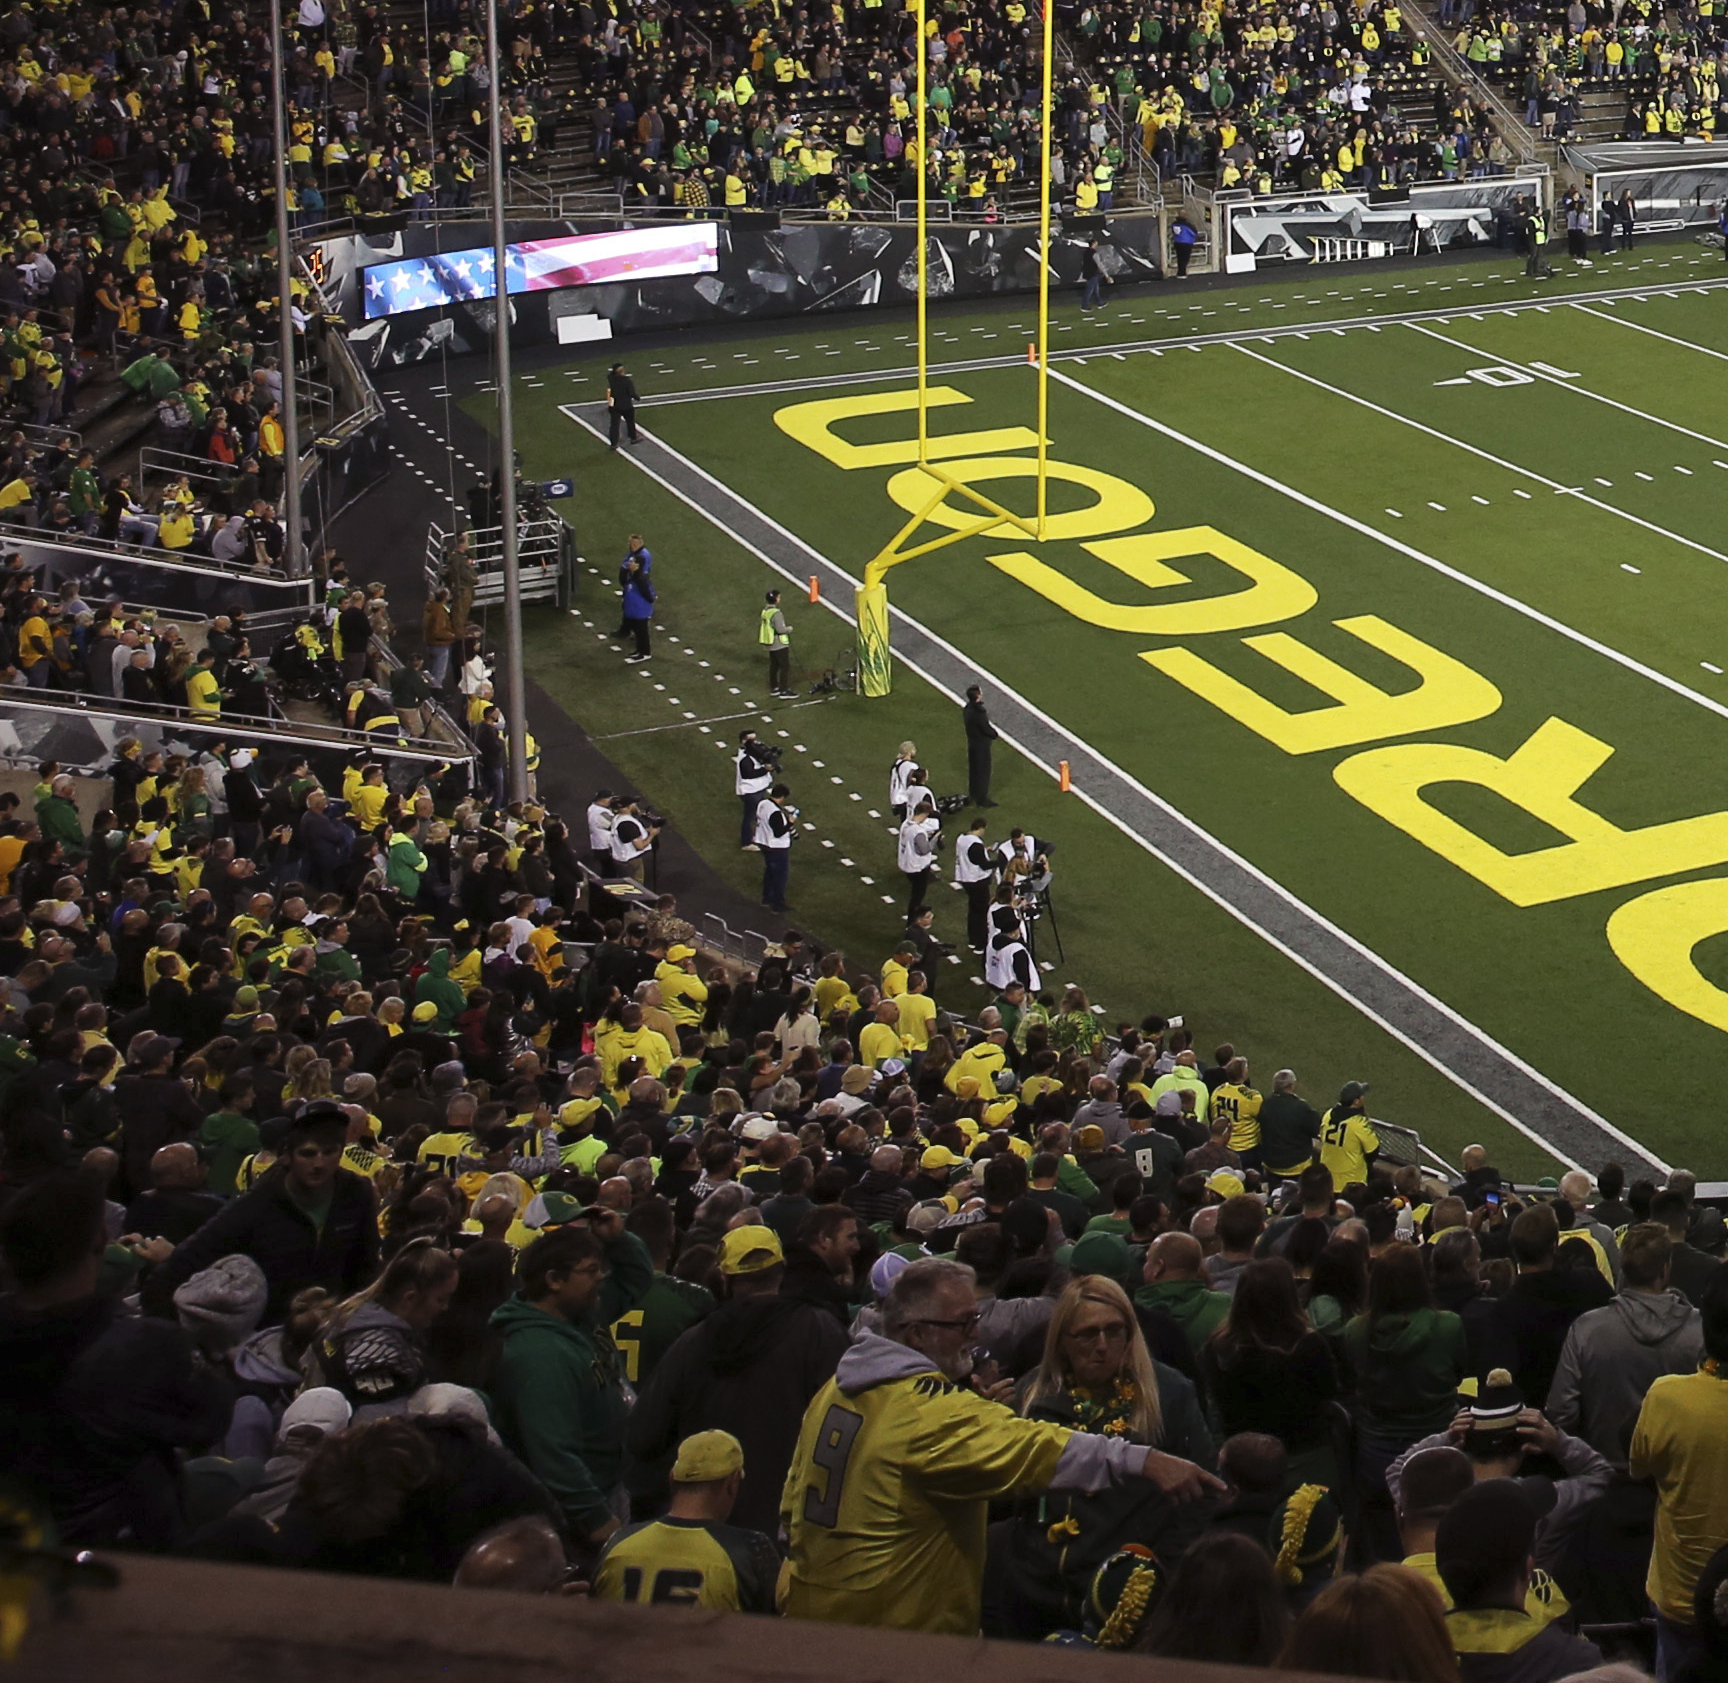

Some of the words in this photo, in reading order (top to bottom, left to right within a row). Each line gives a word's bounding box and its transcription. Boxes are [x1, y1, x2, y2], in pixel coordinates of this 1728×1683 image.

[1466, 360, 1583, 387] 10
[1326, 1123, 1347, 1147] 21
[1135, 1147, 1154, 1178] 8
[803, 1402, 865, 1530] 9
